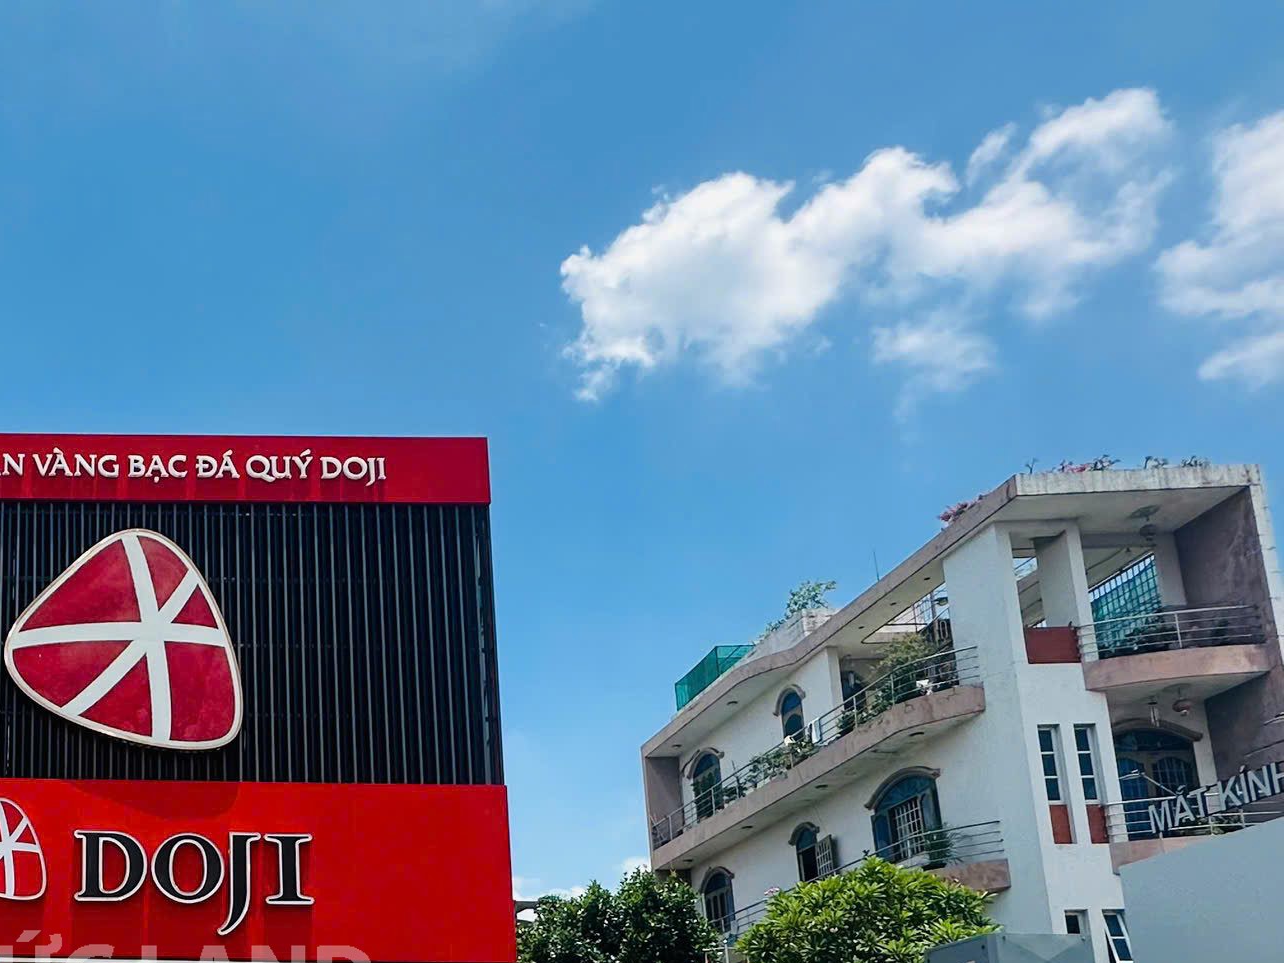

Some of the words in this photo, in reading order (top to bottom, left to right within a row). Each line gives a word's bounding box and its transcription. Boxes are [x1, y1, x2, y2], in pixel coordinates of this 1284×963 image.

[32, 447, 120, 478] VÀNG
[127, 455, 188, 483] BẠC
[195, 449, 240, 480] ĐÁ
[246, 449, 314, 483] QUÝ
[319, 456, 388, 487] DOJI
[1148, 785, 1208, 834] MẮT
[73, 829, 316, 936] DOJI
